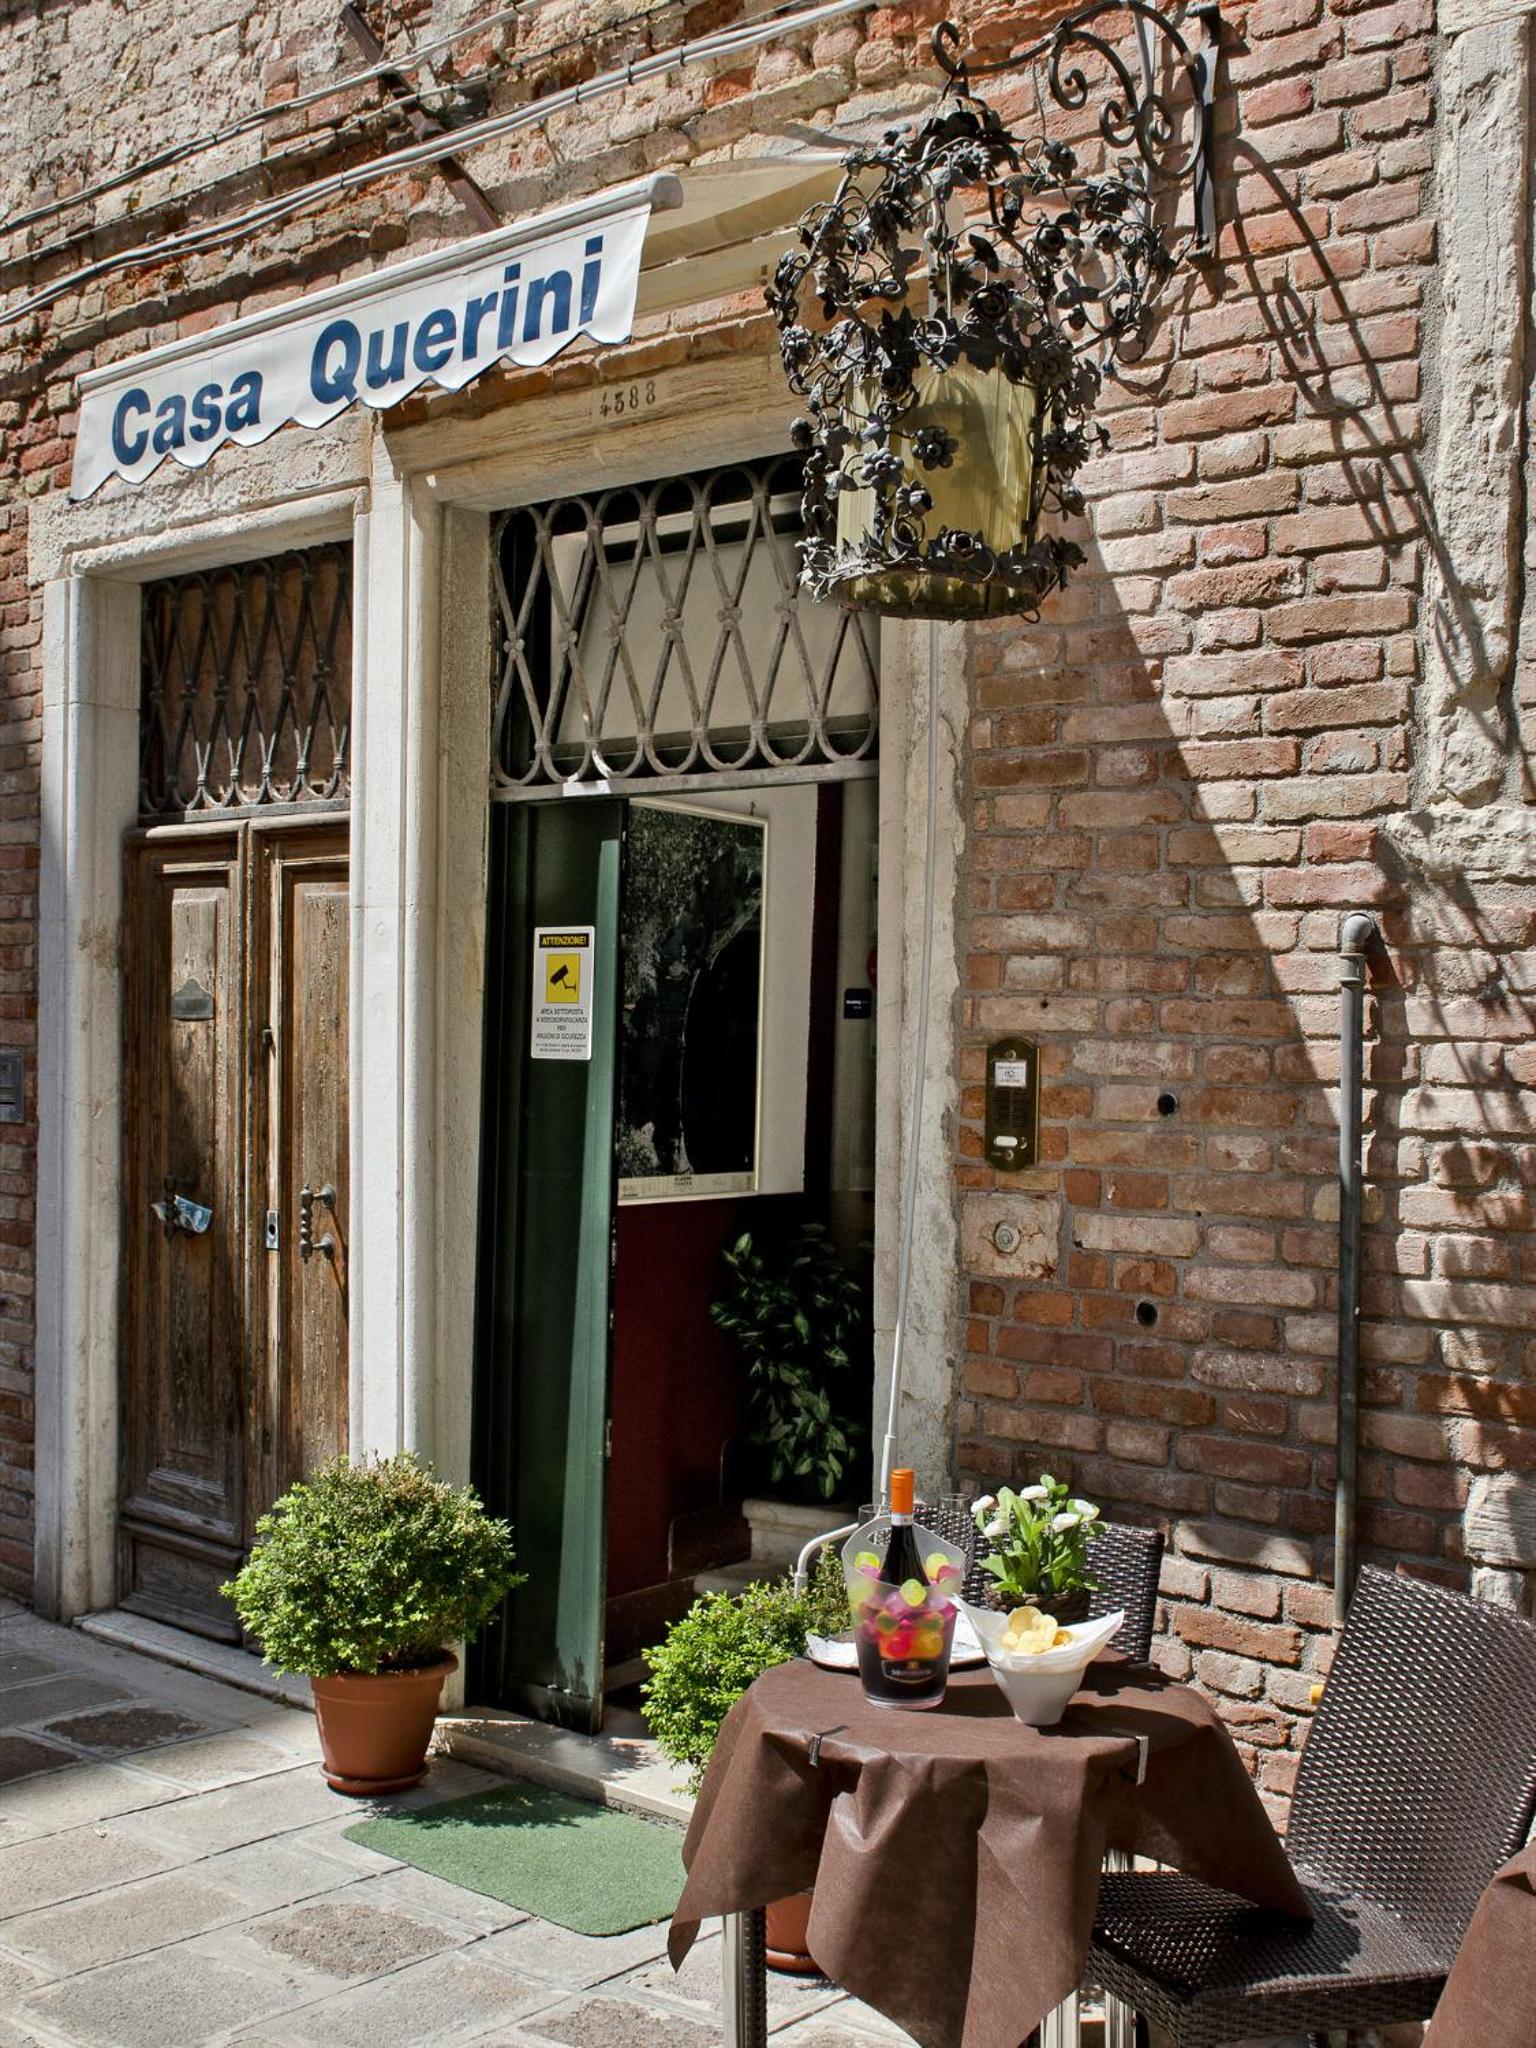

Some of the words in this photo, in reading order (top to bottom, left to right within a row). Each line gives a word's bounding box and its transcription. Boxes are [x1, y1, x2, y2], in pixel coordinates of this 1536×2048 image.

[112, 369, 264, 466] Casa
[309, 235, 604, 405] Querini
[600, 380, 656, 417] 4588
